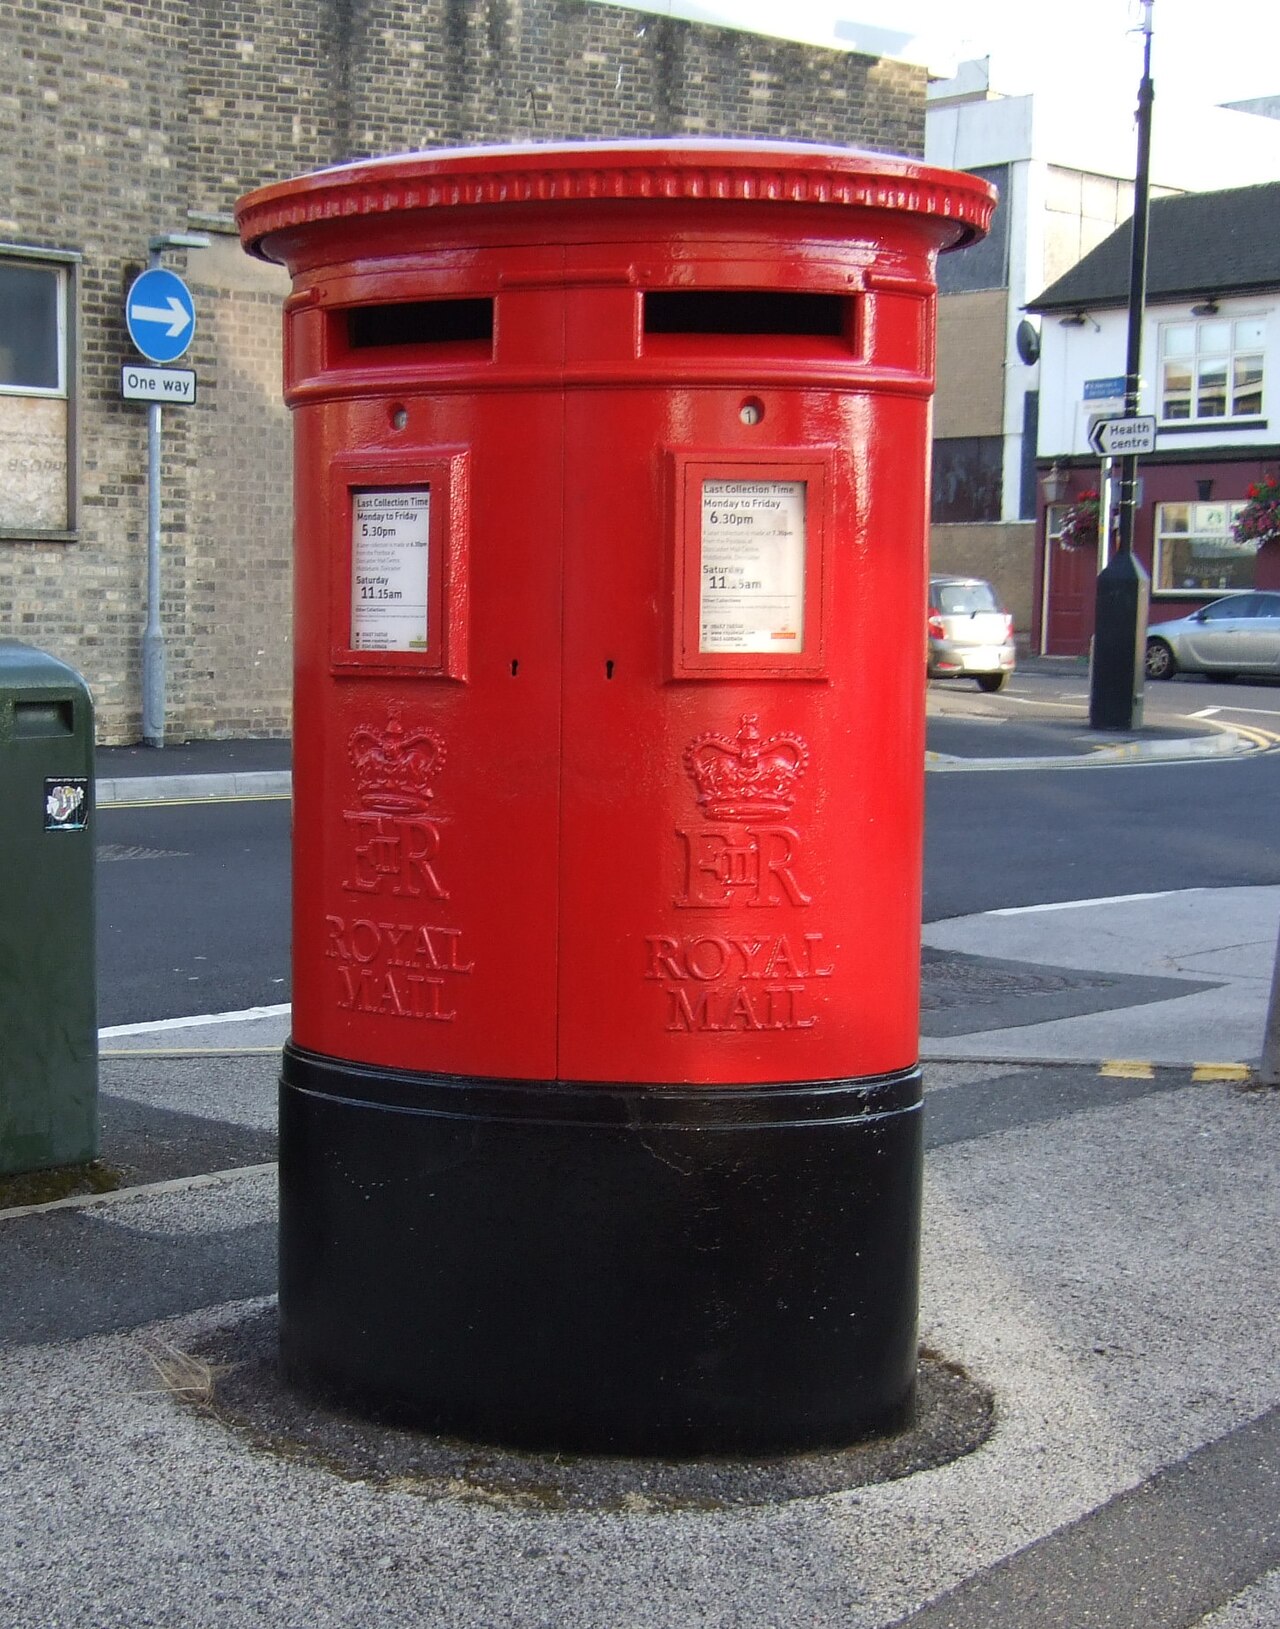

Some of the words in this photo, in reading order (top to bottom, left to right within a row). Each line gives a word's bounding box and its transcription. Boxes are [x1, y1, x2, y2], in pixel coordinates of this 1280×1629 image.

[128, 374, 156, 390] One
[163, 380, 190, 395] way
[1109, 423, 1150, 436] Health
[1111, 439, 1149, 449] centre
[703, 485, 723, 494] Last
[725, 485, 769, 494] Collection
[771, 485, 794, 493] Time
[357, 498, 372, 507] Last
[374, 498, 409, 507] Collection
[411, 497, 428, 506] Time
[703, 499, 739, 509] Monday
[741, 500, 750, 508] to
[752, 499, 781, 509] Friday
[357, 512, 385, 522] Monday
[395, 512, 417, 522] Friday
[709, 511, 753, 526] 6.30pm
[362, 524, 397, 538] 5.30pm
[702, 564, 745, 575] Saturday
[356, 575, 389, 586] Saturday
[361, 586, 403, 599] 11.15am
[324, 914, 475, 974] ROYAL
[644, 932, 835, 981] ROYAL
[336, 965, 457, 1022] MAIL
[665, 984, 819, 1033] MAIL
